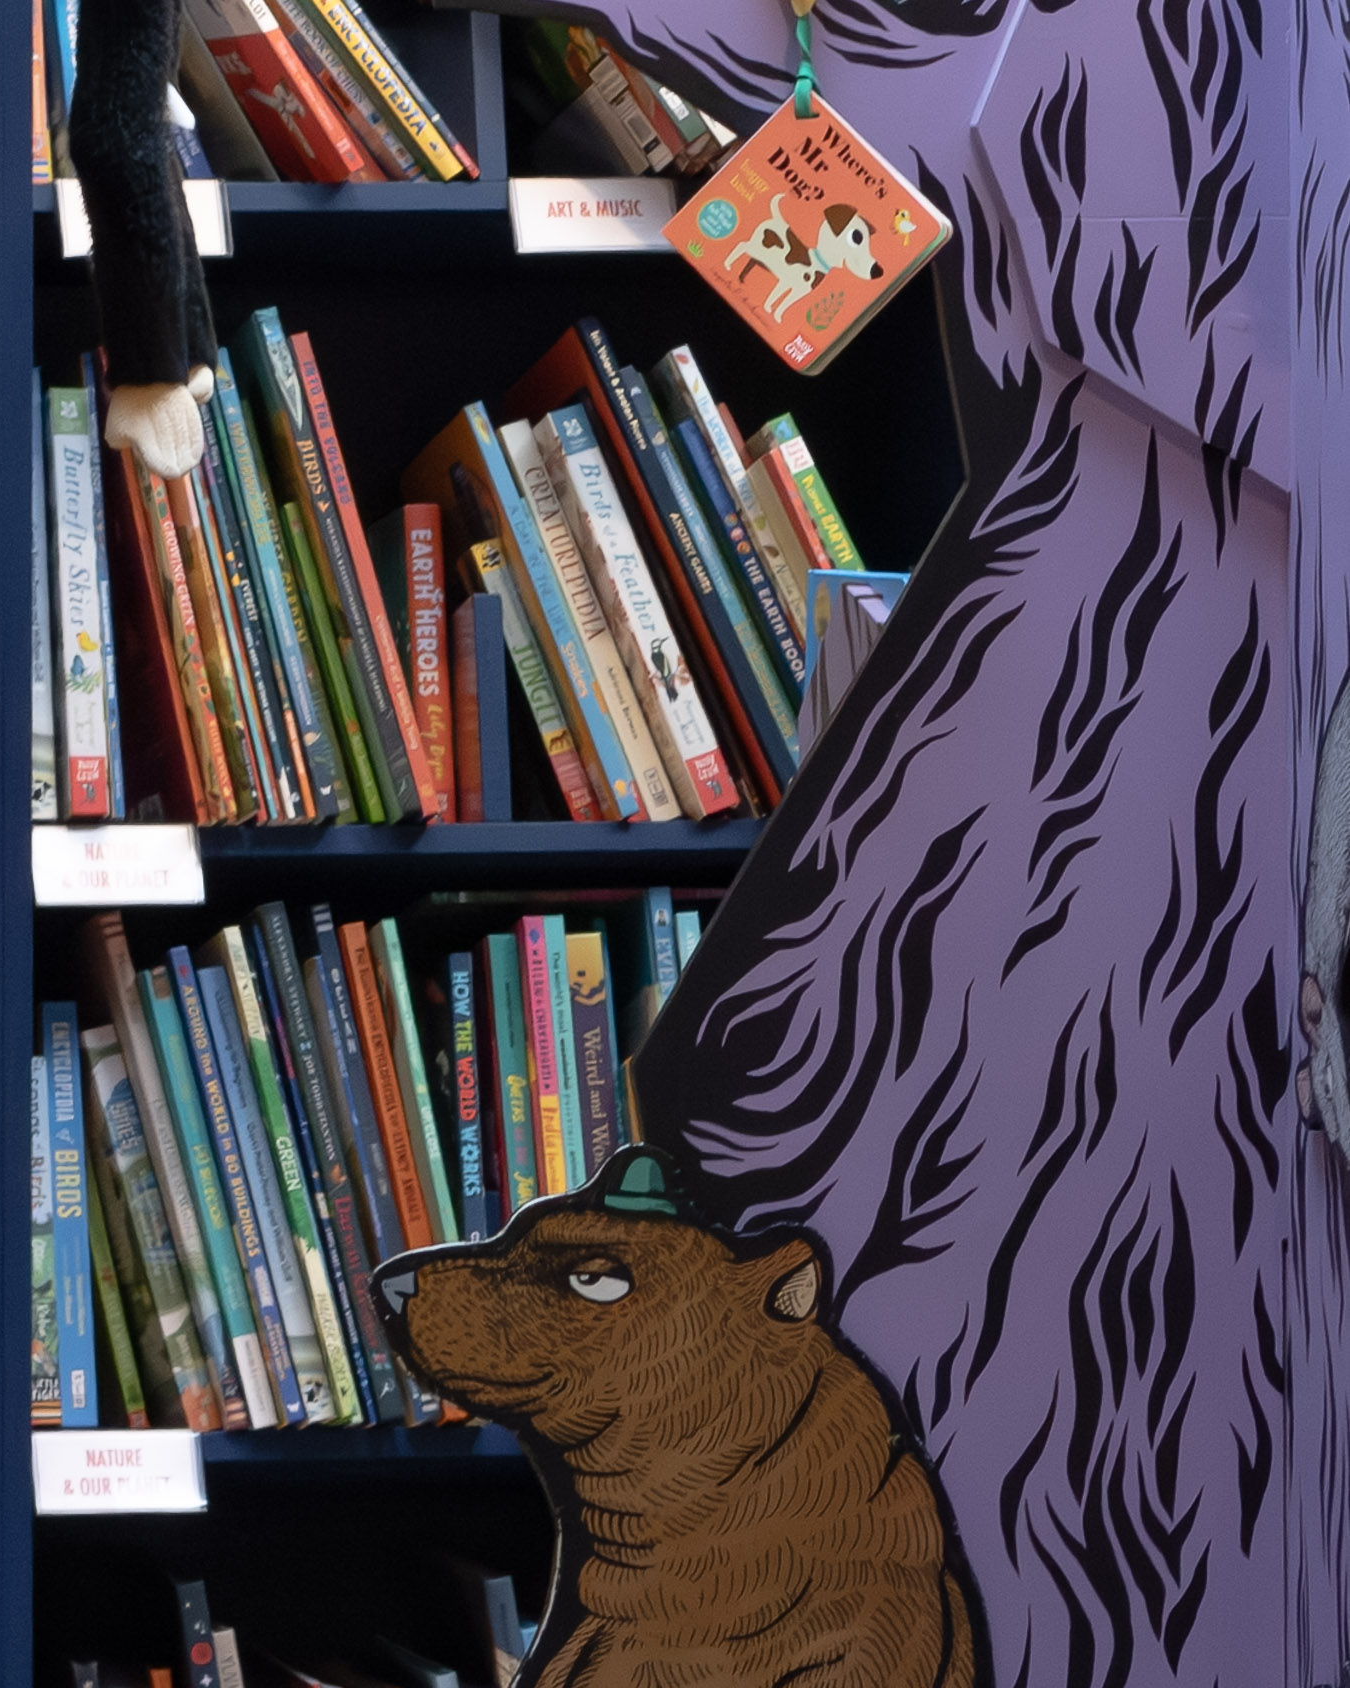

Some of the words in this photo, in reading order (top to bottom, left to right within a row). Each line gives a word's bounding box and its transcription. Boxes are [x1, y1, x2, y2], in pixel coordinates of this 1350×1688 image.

[766, 146, 825, 202] Dog?
[794, 136, 829, 174] Mr
[821, 124, 888, 200] Where's
[548, 200, 574, 218] ART
[580, 201, 592, 217] &
[596, 199, 643, 217] MUSIC
[296, 438, 326, 496] BIRDS
[63, 445, 88, 556] Butterfly
[162, 520, 187, 582] GROWING
[409, 527, 437, 599] EARTH
[524, 466, 608, 642] CREATUREPEDIA
[579, 463, 615, 520] Birds
[612, 552, 658, 633] Feather
[669, 513, 695, 556] ANCIENT
[689, 558, 713, 594] GAMES
[821, 514, 854, 564] EARTH
[69, 564, 94, 625] Skies
[173, 584, 195, 629] GREEN
[743, 557, 766, 585] THE
[758, 588, 790, 636] EARTH
[780, 638, 806, 683] BOOK
[414, 608, 440, 697] HEROES
[180, 983, 209, 1050] AROUND
[452, 971, 470, 1016] HOW
[200, 1053, 214, 1076] the
[302, 1054, 317, 1076] JOE
[455, 1020, 472, 1053] THE
[583, 1026, 603, 1086] Weird
[50, 1021, 75, 1123] ENCYCLOPEDIA
[456, 1056, 476, 1121] WORLD
[205, 1078, 231, 1135] WORLD
[590, 1089, 608, 1119] and
[221, 1138, 234, 1151] in
[225, 1154, 242, 1175] 80
[275, 1136, 301, 1192] GREEN
[461, 1125, 481, 1198] WORKS
[53, 1148, 82, 1220] BIRDS
[230, 1177, 261, 1258] BUILDINGS
[64, 1479, 75, 1495] &
[80, 1477, 111, 1495] OUR
[86, 1448, 143, 1467] NATURE
